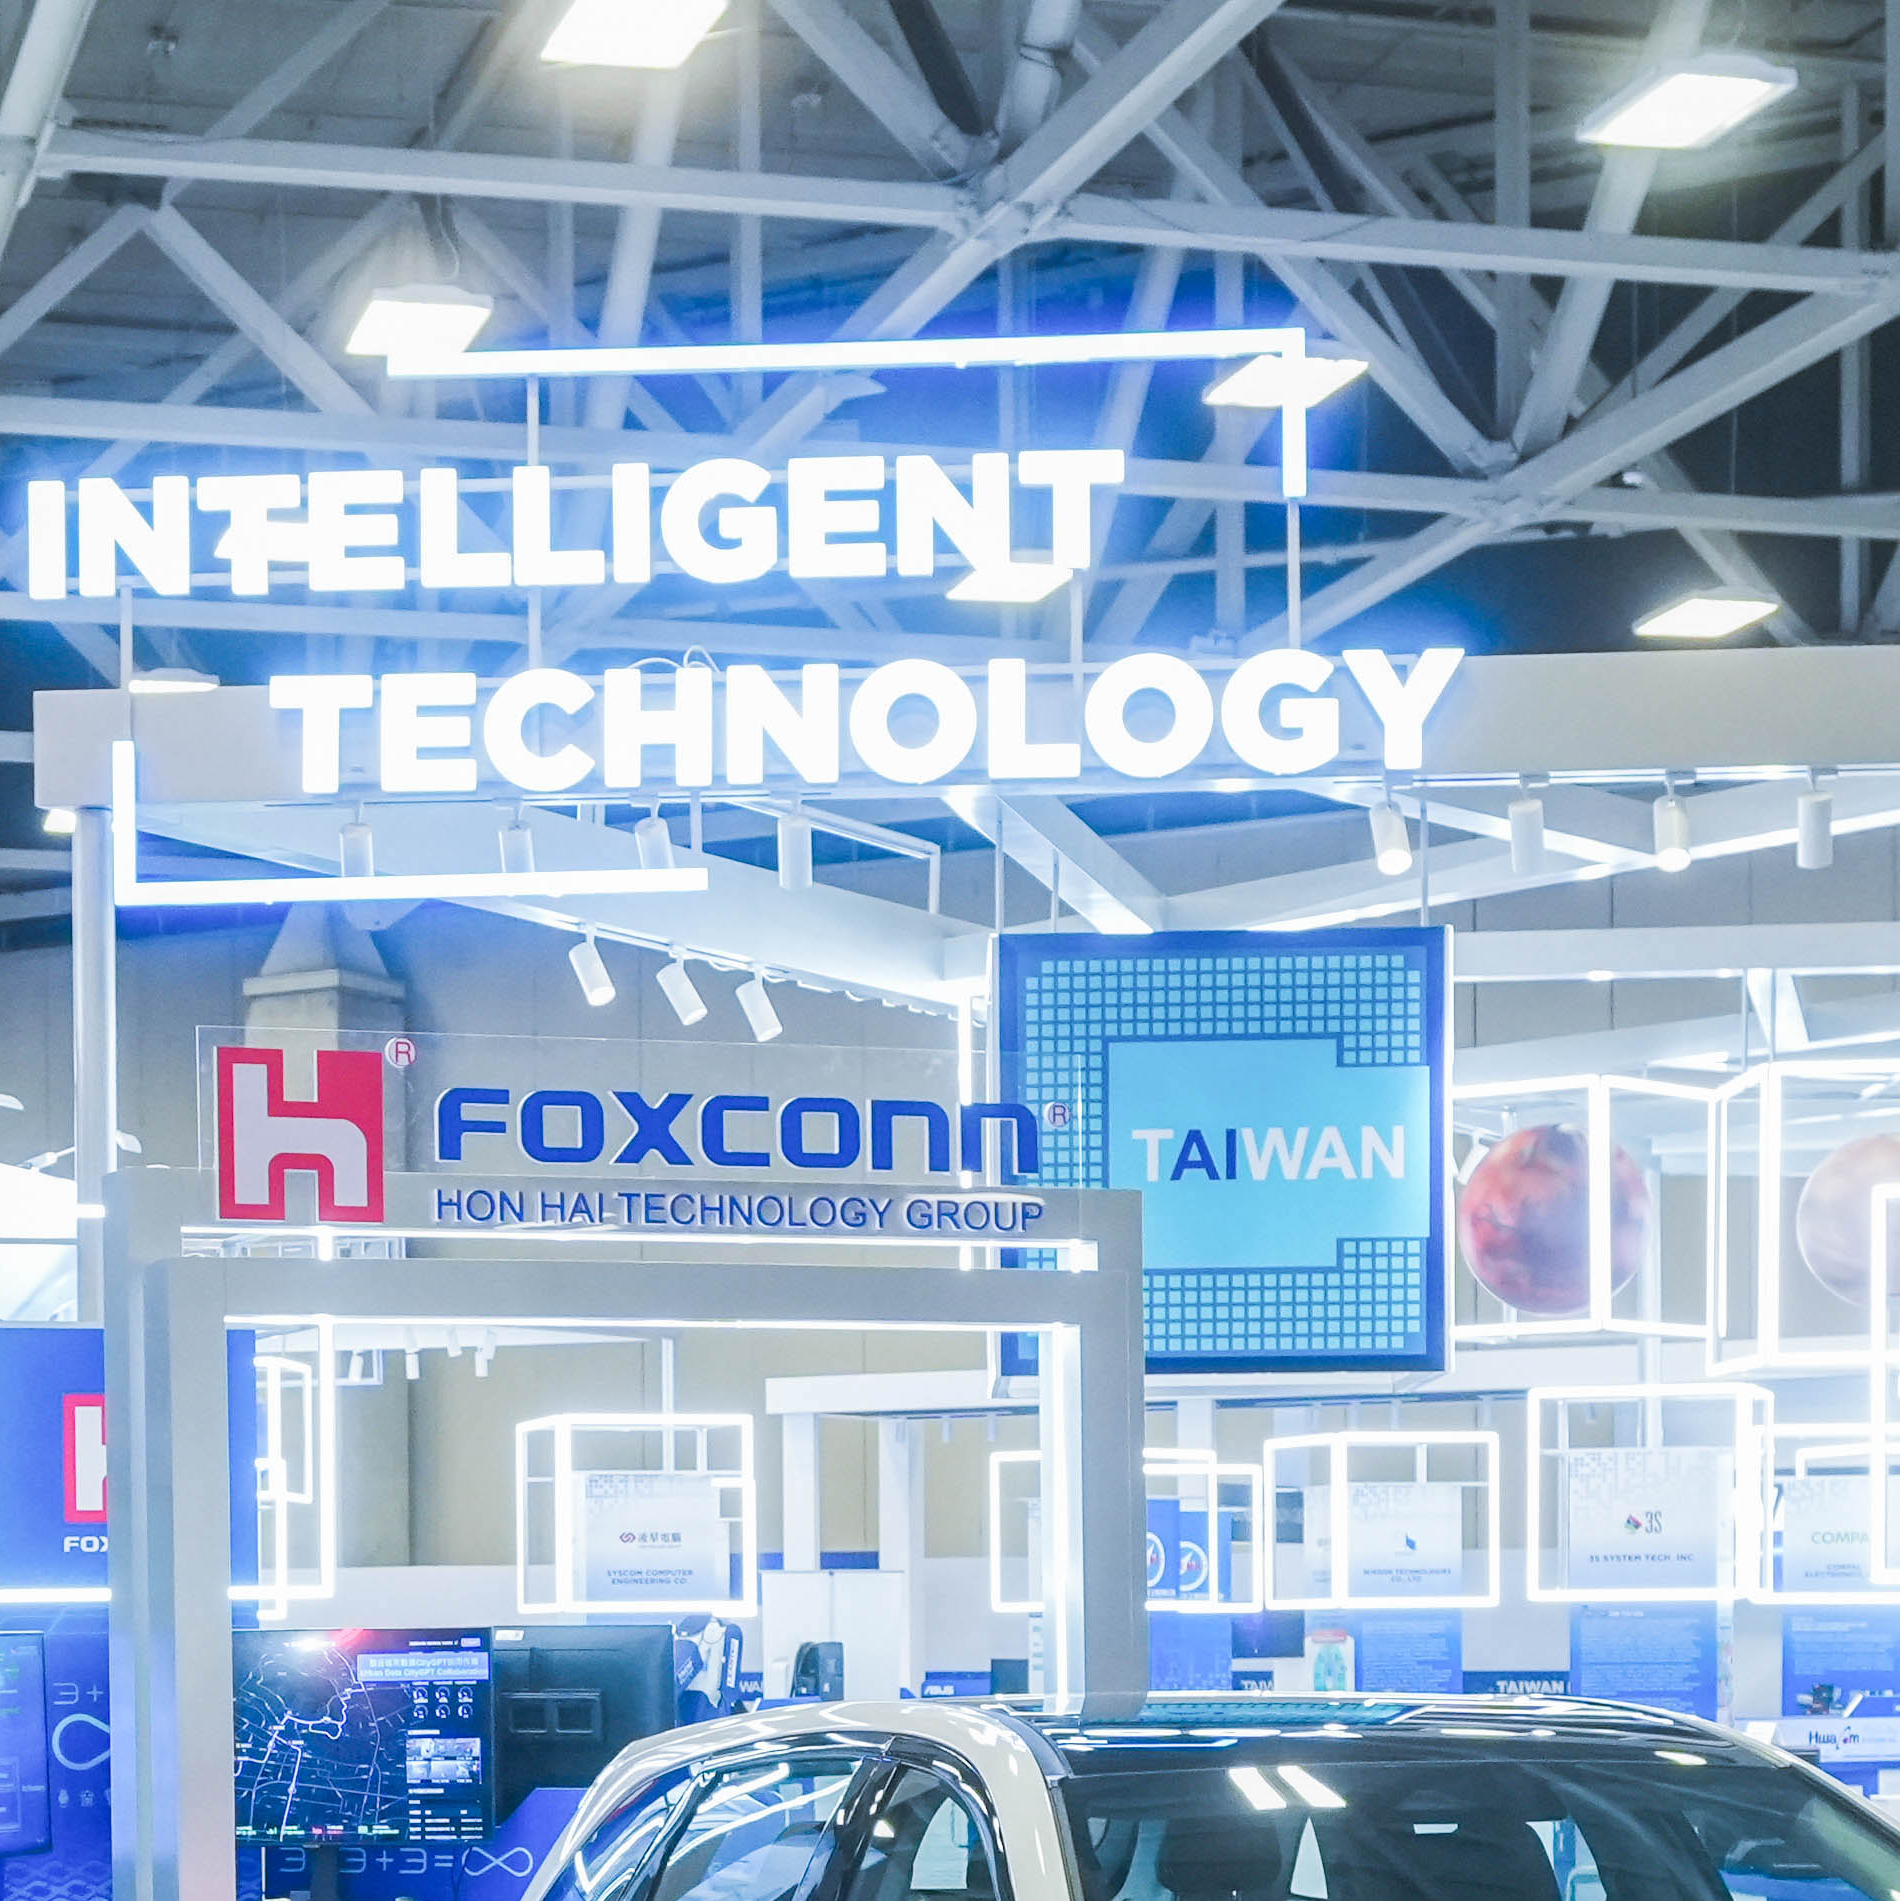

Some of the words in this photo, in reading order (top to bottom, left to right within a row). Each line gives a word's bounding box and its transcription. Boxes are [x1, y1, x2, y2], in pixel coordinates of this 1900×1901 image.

[28, 449, 1124, 600] INTELLIGENT
[268, 648, 1465, 794] TECHNOLOGY
[435, 1087, 1040, 1176] FOXCONN
[1133, 1122, 1406, 1184] TAIWAN
[437, 1189, 524, 1225] HON
[541, 1191, 606, 1227] HAI
[621, 1193, 887, 1231] TECHNOLOGY
[904, 1198, 1044, 1234] GROUP
[1645, 1511, 1662, 1534] 3S
